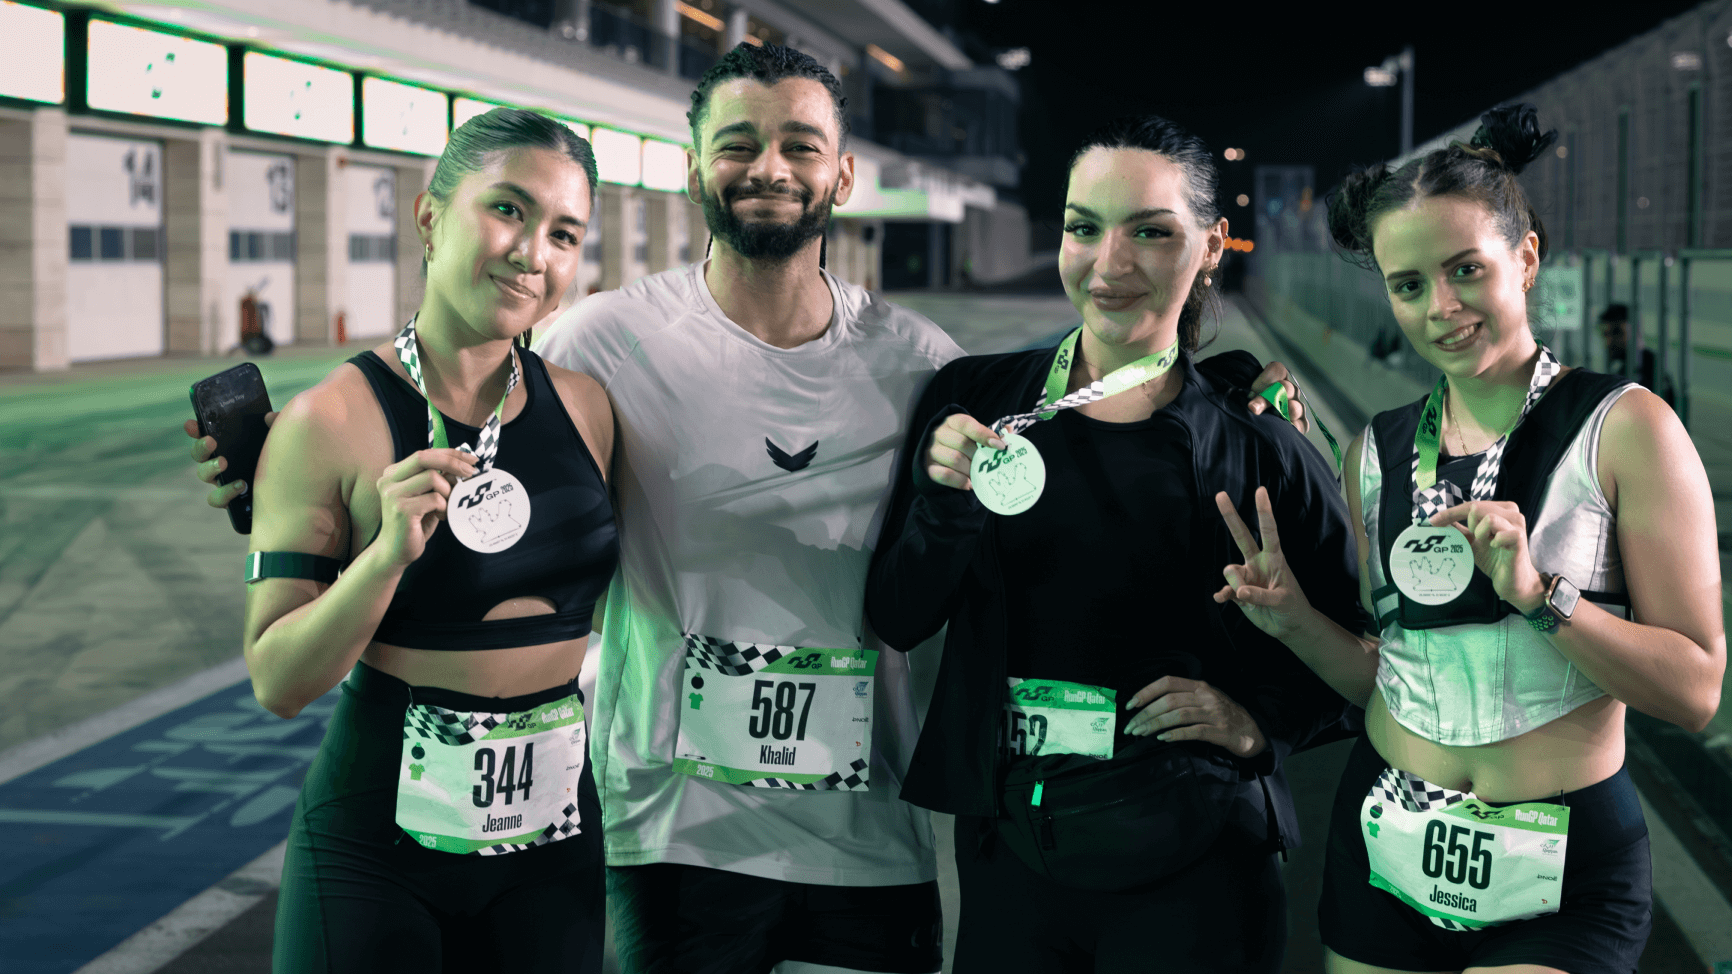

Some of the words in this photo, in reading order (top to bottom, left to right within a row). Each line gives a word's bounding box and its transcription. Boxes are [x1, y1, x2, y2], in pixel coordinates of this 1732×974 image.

[123, 149, 155, 206] 14
[1003, 454, 1015, 464] GP
[486, 490, 499, 500] GP
[1450, 544, 1464, 553] 2025
[830, 656, 850, 668] RunGP
[850, 657, 867, 669] Qatar
[1063, 689, 1086, 703] RunGP
[1086, 691, 1105, 704] Qatar
[749, 679, 816, 741] 587
[759, 744, 796, 766] Khalid
[472, 742, 535, 808] 344
[696, 764, 714, 778] 2025
[482, 813, 522, 832] Jeanne
[1515, 808, 1538, 823] RunGP
[1538, 811, 1558, 826] Qatar
[419, 834, 437, 848] 2025
[1422, 819, 1495, 890] 655
[1429, 884, 1477, 912] Jessica
